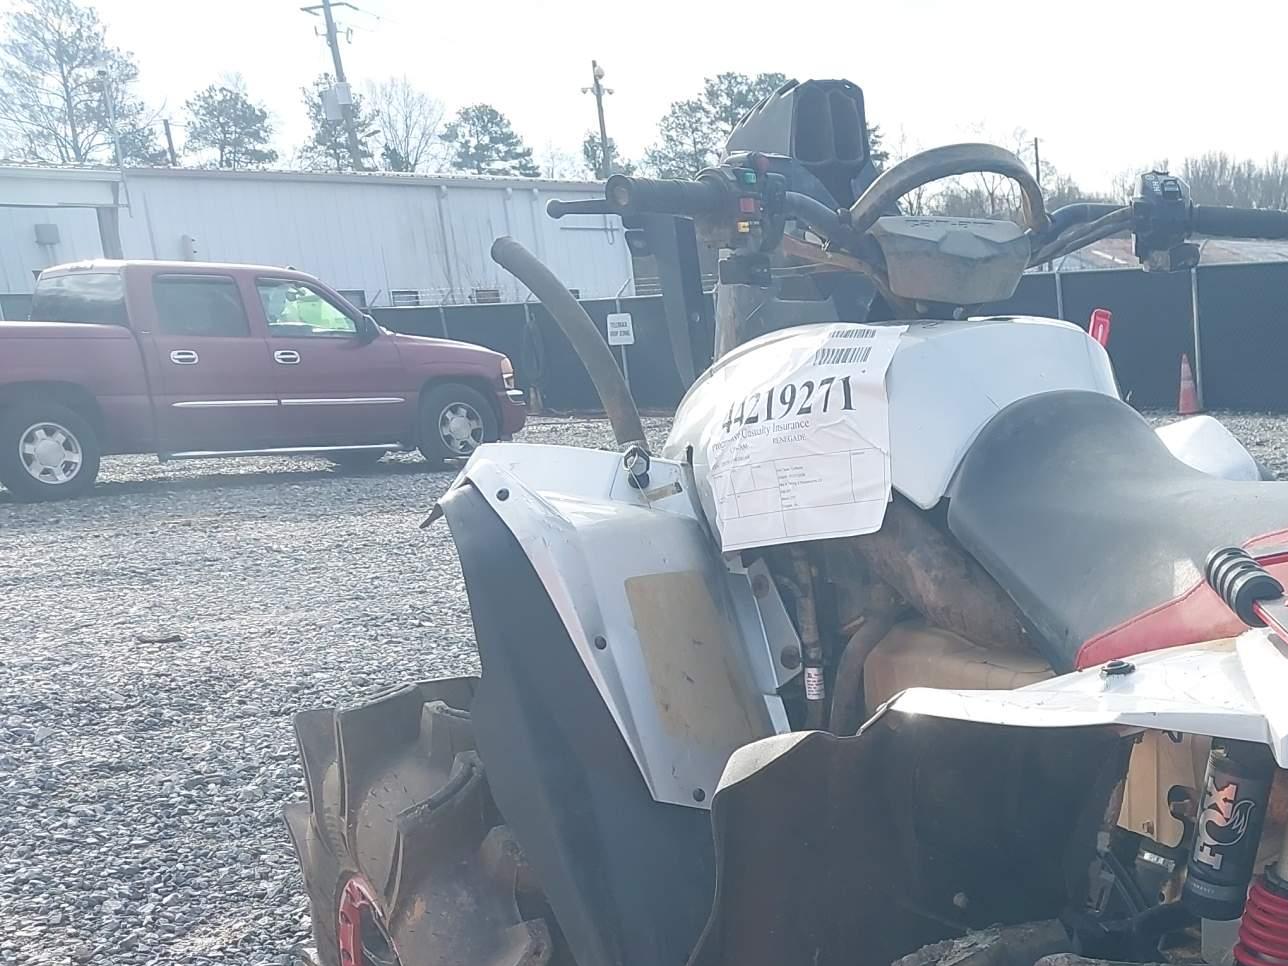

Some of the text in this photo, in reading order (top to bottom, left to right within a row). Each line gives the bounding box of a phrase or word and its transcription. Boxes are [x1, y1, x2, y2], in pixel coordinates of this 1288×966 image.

[722, 375, 857, 433] 44219271
[772, 419, 810, 434] Insurance
[1192, 775, 1255, 870] FOX
